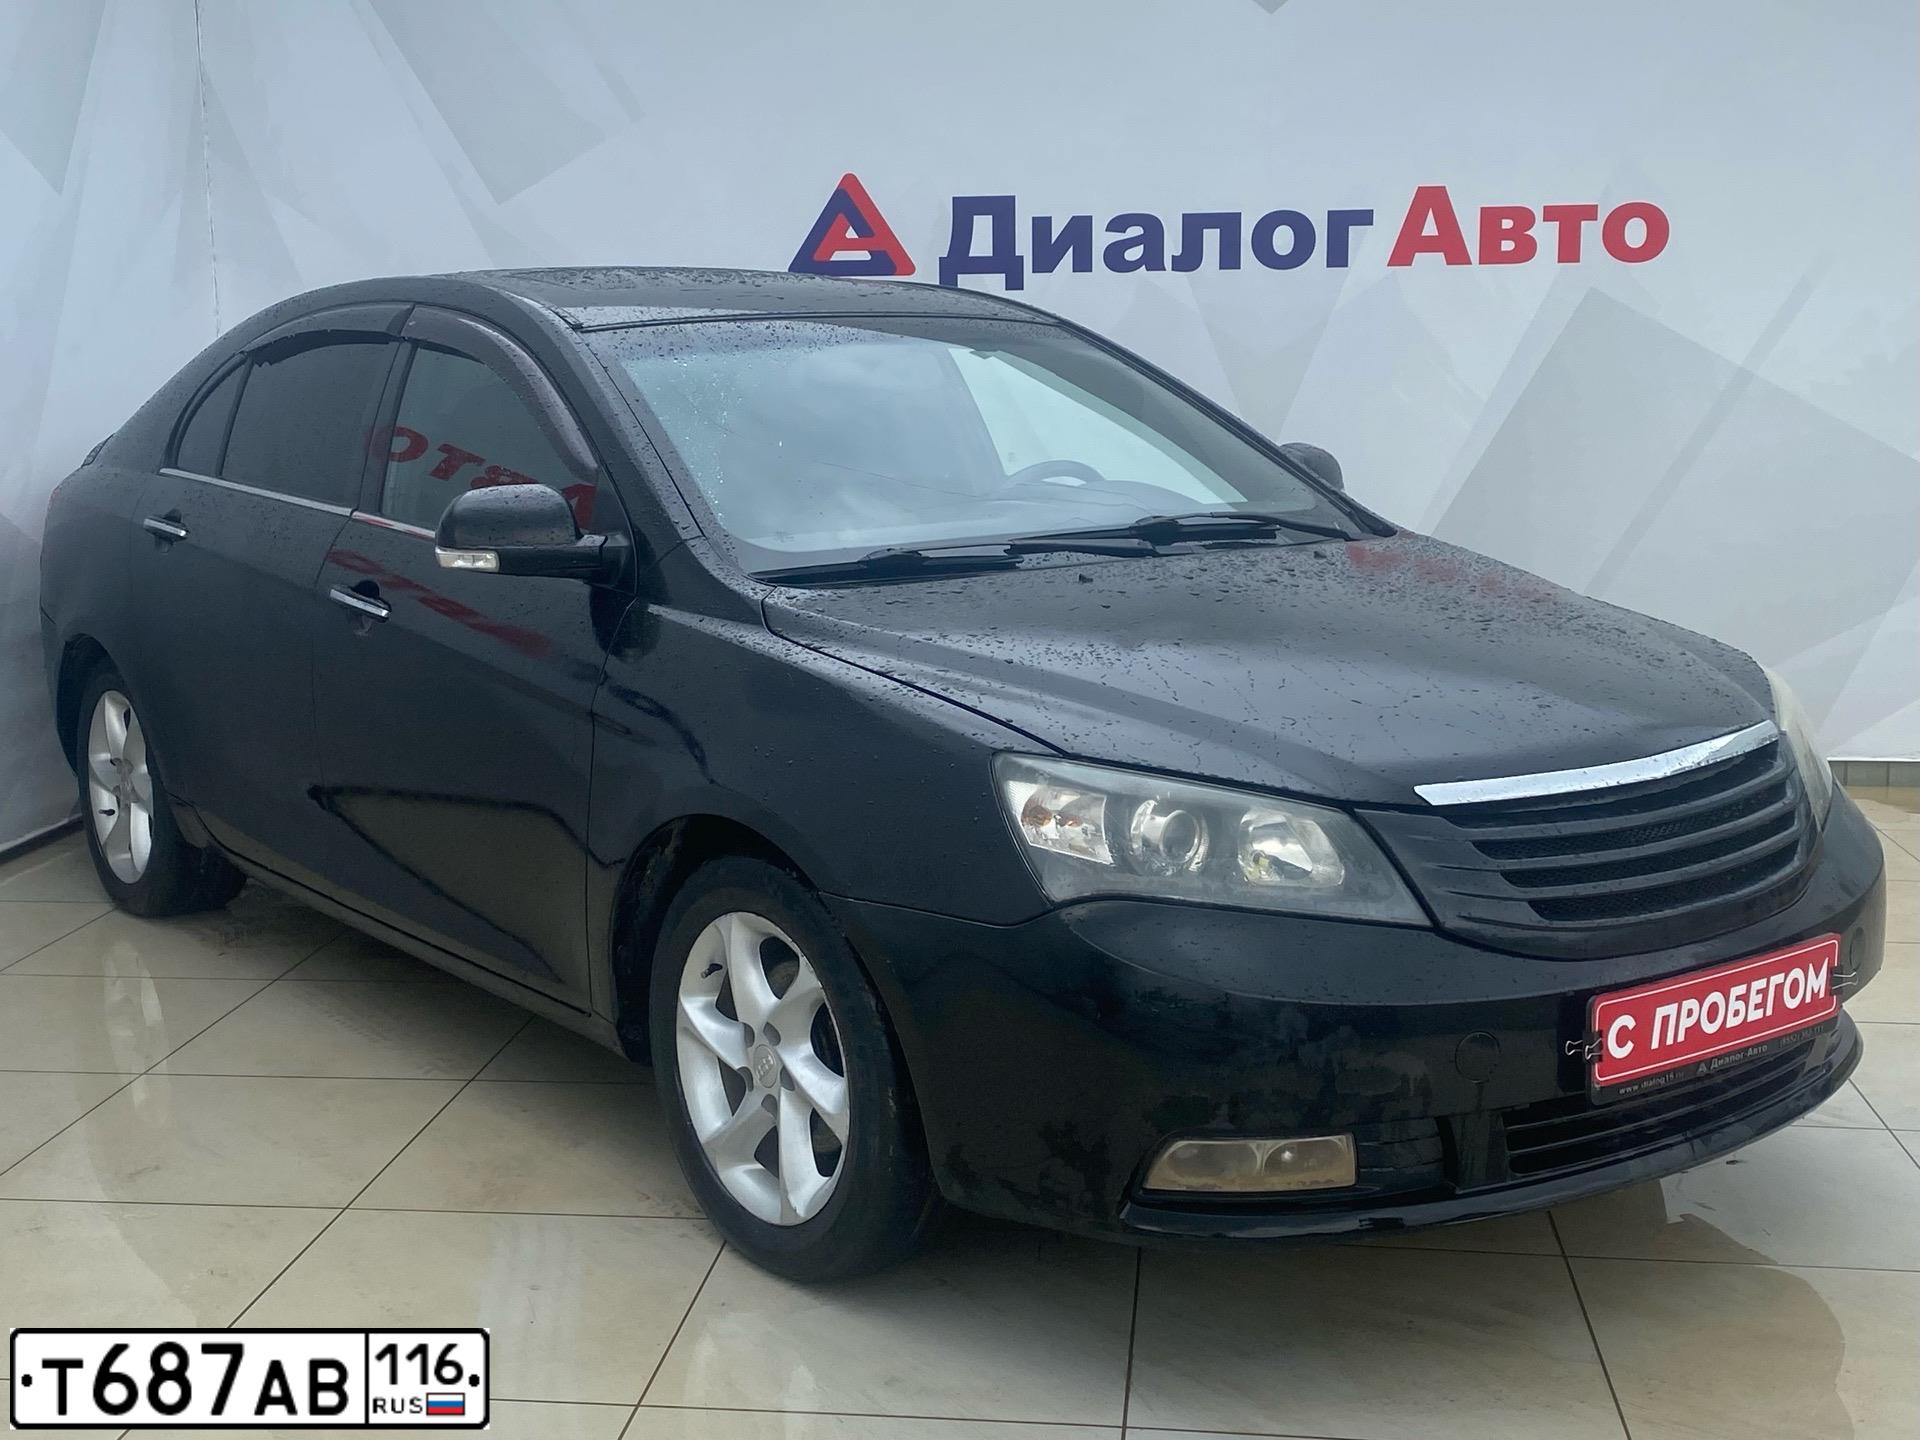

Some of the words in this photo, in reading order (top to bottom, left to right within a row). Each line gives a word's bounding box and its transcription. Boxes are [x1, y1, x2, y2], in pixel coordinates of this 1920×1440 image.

[938, 195, 1374, 290] Диалог
[1387, 185, 1670, 267] Авто
[1607, 1014, 1637, 1060] С
[1650, 957, 1829, 1050] ПРОБЕГОМ
